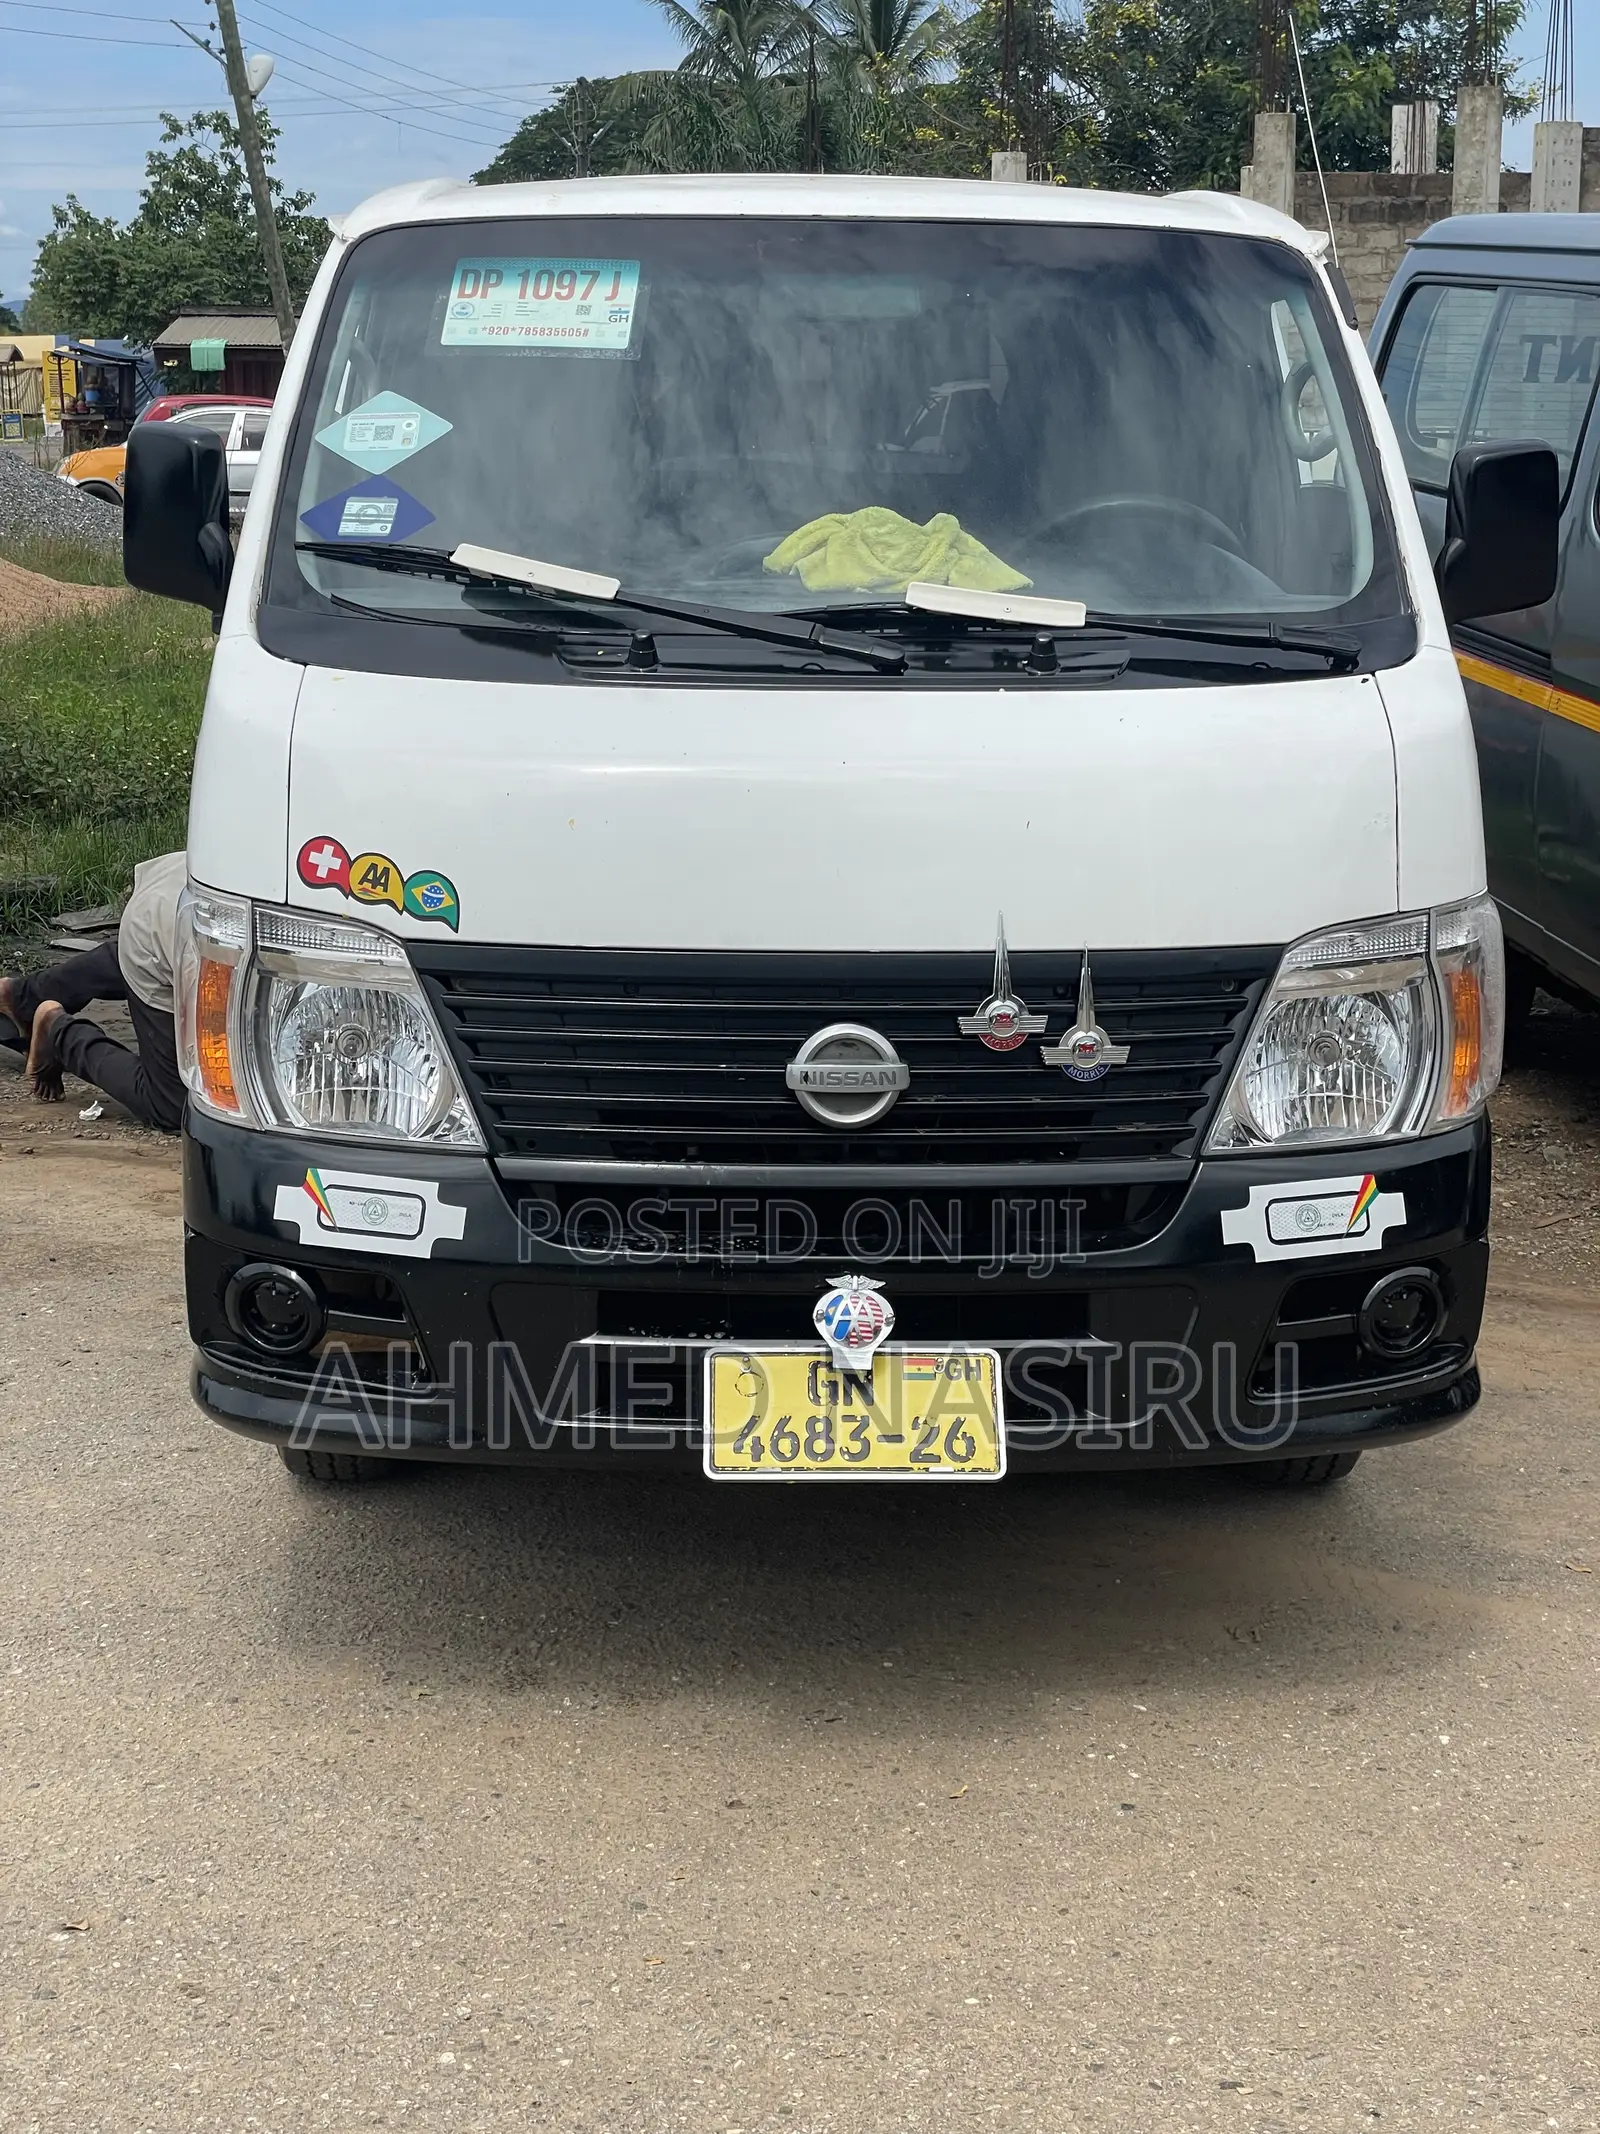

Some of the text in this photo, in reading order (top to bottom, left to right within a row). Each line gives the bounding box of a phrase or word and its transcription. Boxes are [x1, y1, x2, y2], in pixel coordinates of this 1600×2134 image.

[457, 268, 504, 299] DP
[608, 314, 629, 324] GH
[358, 862, 391, 893] AA
[983, 1034, 1027, 1051] MORRIS
[799, 1069, 898, 1087] NISSAN
[1067, 1064, 1106, 1081] MORRIS
[944, 1358, 982, 1382] GH
[808, 1360, 874, 1407] GN
[733, 1414, 977, 1464] 4683-26
